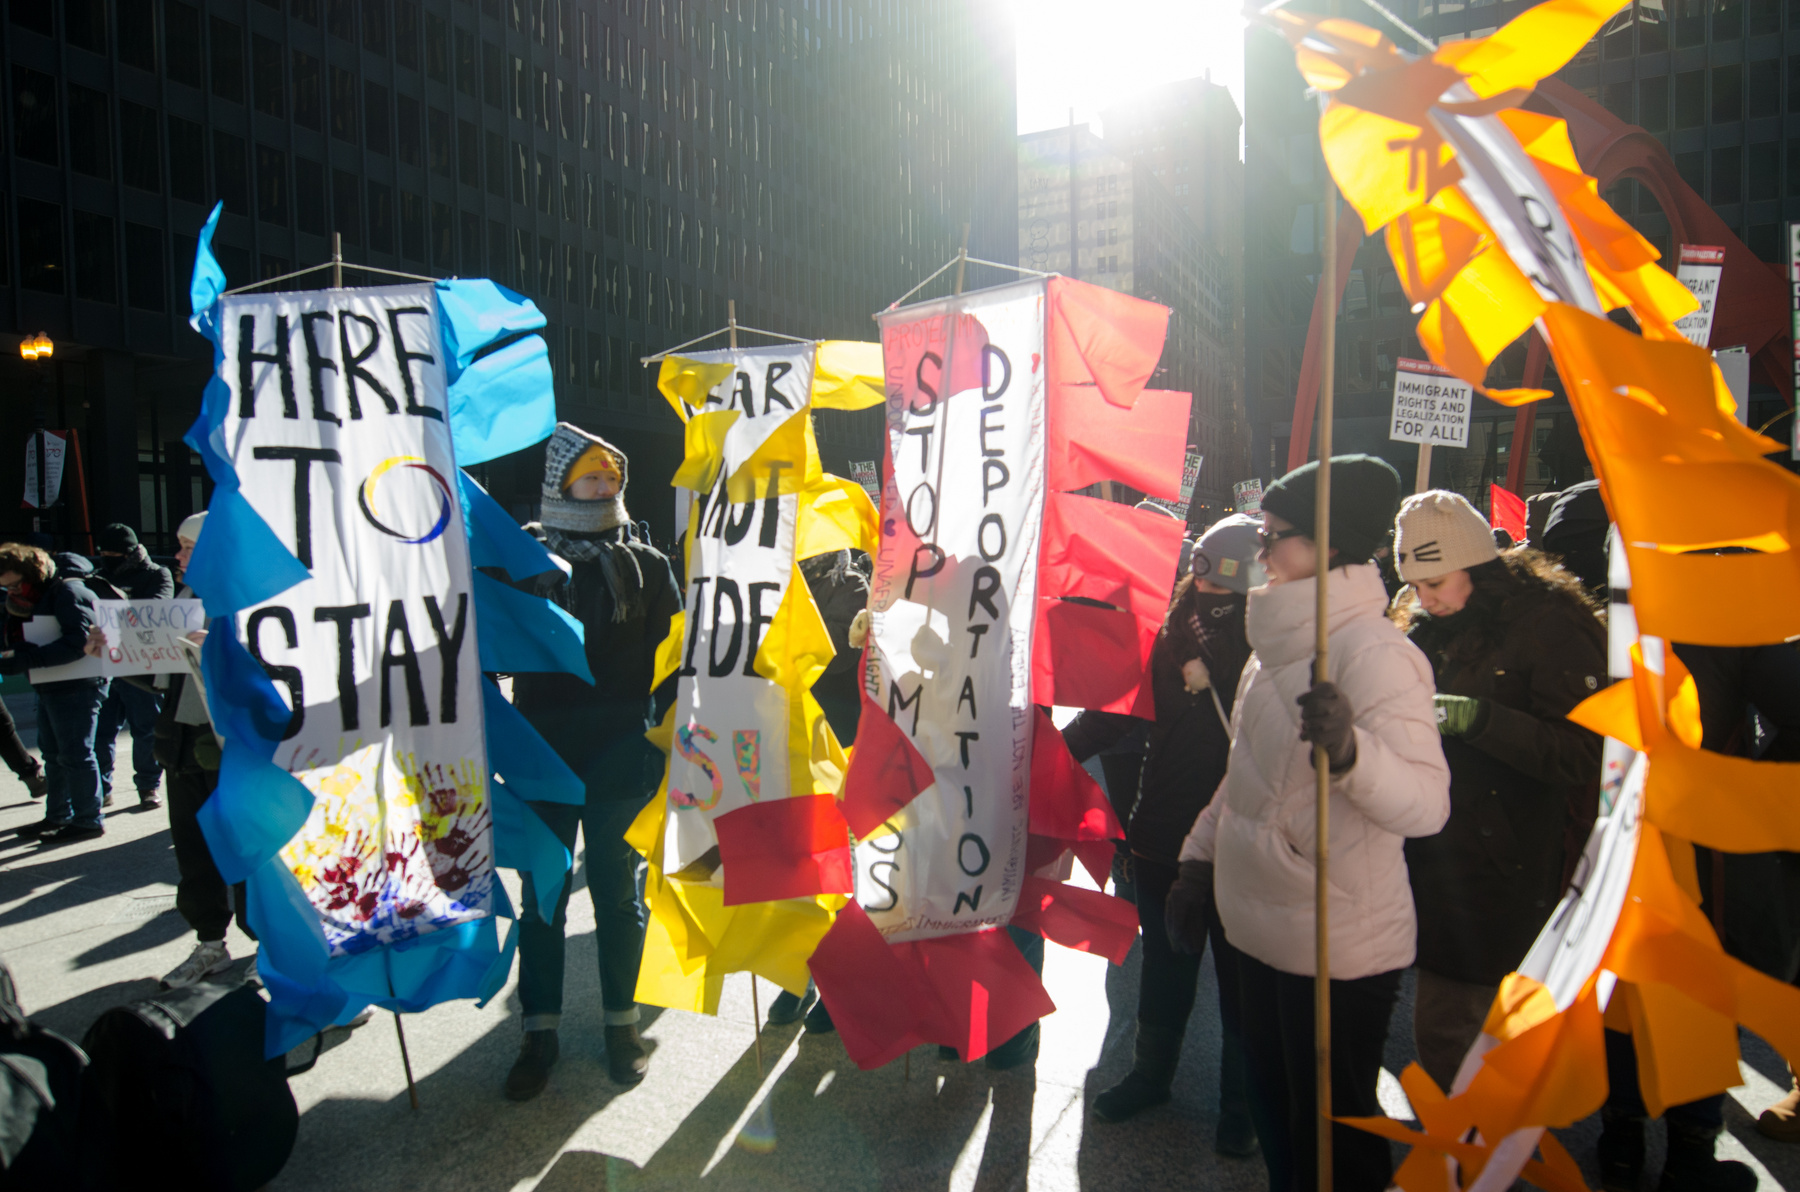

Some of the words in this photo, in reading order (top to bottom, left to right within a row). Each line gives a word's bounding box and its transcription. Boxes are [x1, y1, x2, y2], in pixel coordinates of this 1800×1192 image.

[887, 314, 952, 352] PROTEC
[238, 306, 443, 427] HERE
[1398, 395, 1436, 411] RIGHTS
[1441, 402, 1465, 413] AND
[1399, 381, 1467, 400] IMMIGRANT
[1395, 420, 1423, 437] FOR
[1430, 425, 1463, 441] ALL!
[1397, 408, 1464, 424] LEGALIZATION
[858, 462, 874, 472] THE
[905, 351, 944, 600] STOP
[1243, 480, 1260, 490] THE
[253, 446, 455, 570] TO
[99, 605, 194, 629] DEMOCRACY
[953, 343, 1012, 915] DEPORTATION
[109, 634, 185, 670] Oligarch
[247, 593, 468, 741] STAY
[1012, 737, 1026, 772] NOT
